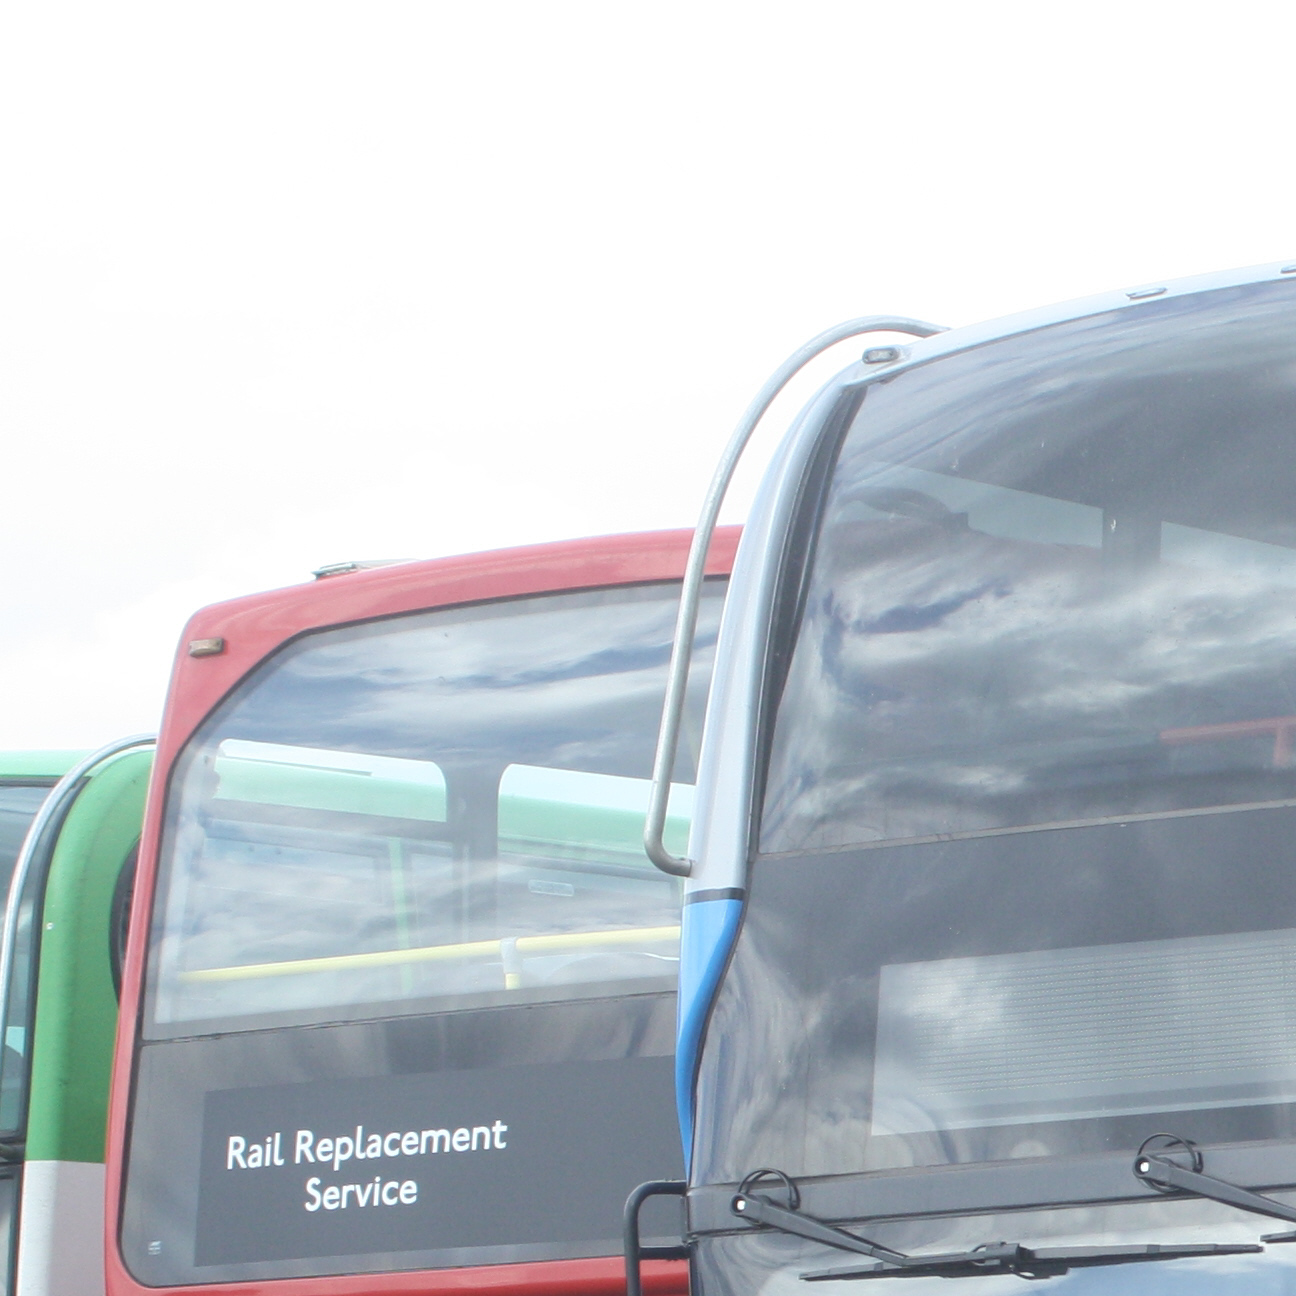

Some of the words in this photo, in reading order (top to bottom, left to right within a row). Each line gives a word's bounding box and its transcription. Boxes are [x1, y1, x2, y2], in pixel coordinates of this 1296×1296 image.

[226, 1132, 285, 1170] Rail
[294, 1120, 508, 1171] Replacement
[305, 1176, 418, 1212] Service
